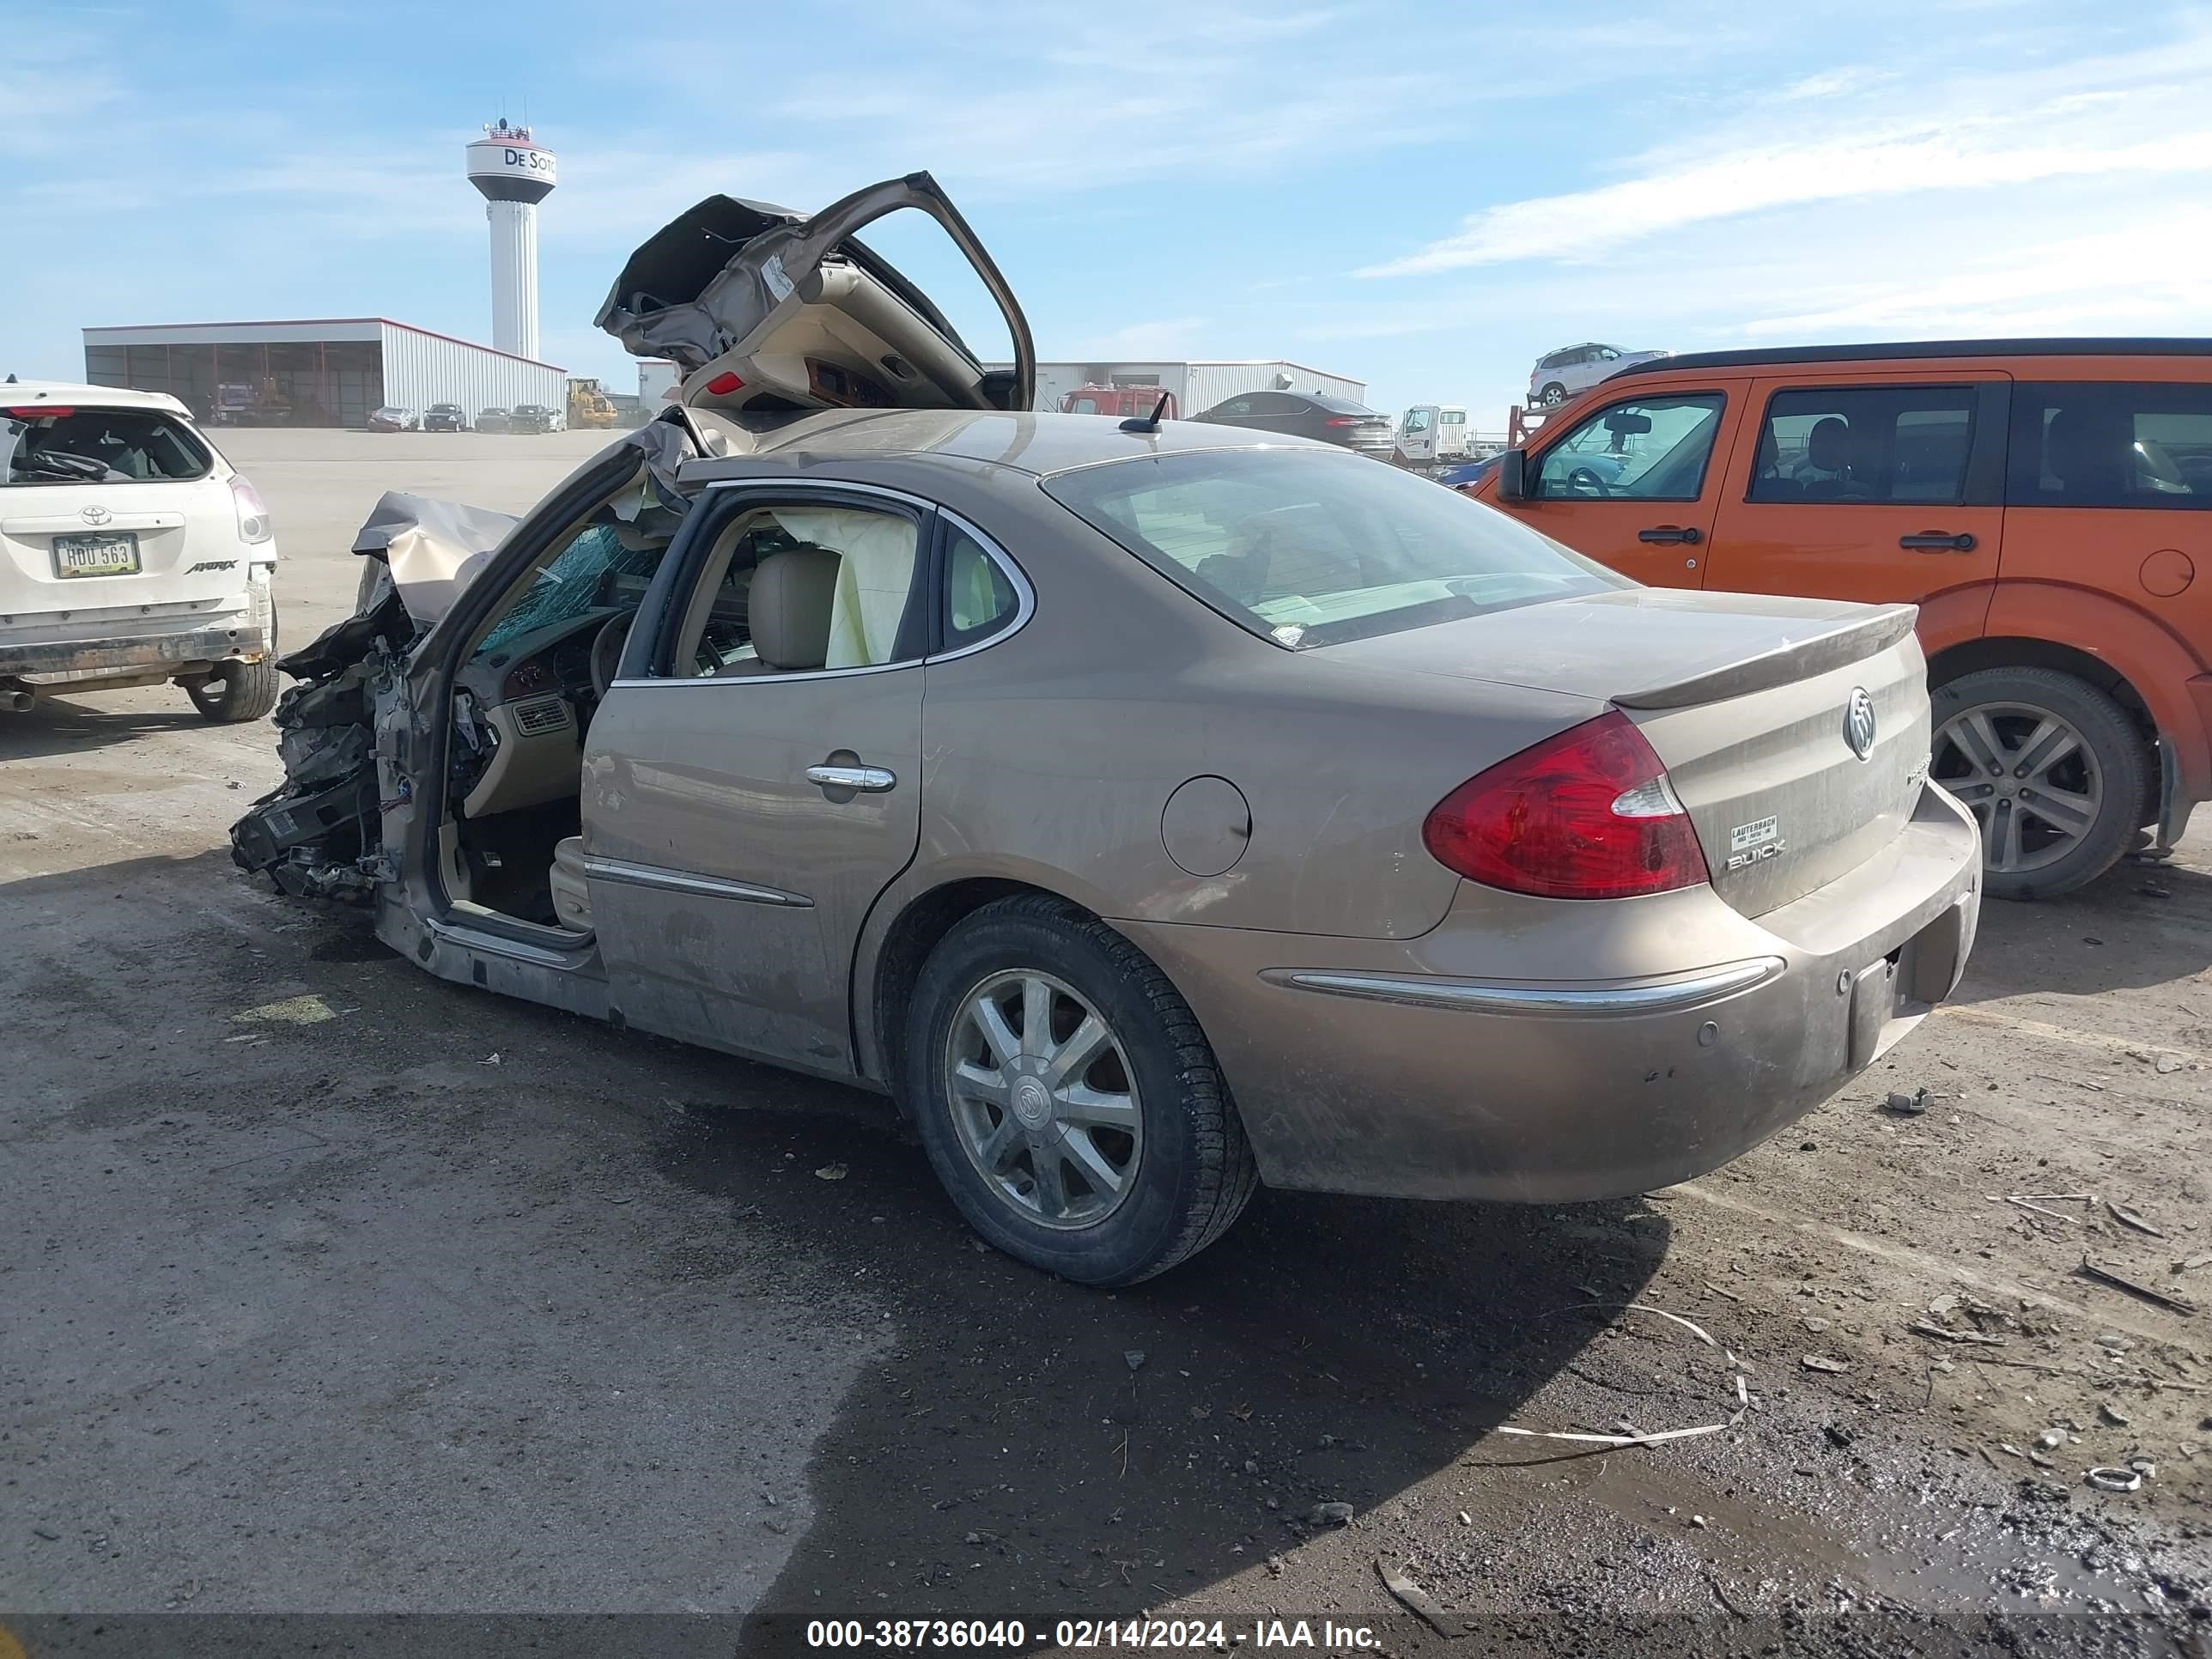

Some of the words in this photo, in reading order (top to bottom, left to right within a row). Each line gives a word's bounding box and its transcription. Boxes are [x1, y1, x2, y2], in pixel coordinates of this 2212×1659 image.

[67, 548, 96, 567] HDU
[100, 546, 128, 564] 563
[1732, 817, 1776, 839] LAUTERBACH
[1725, 839, 1786, 871] BUICK
